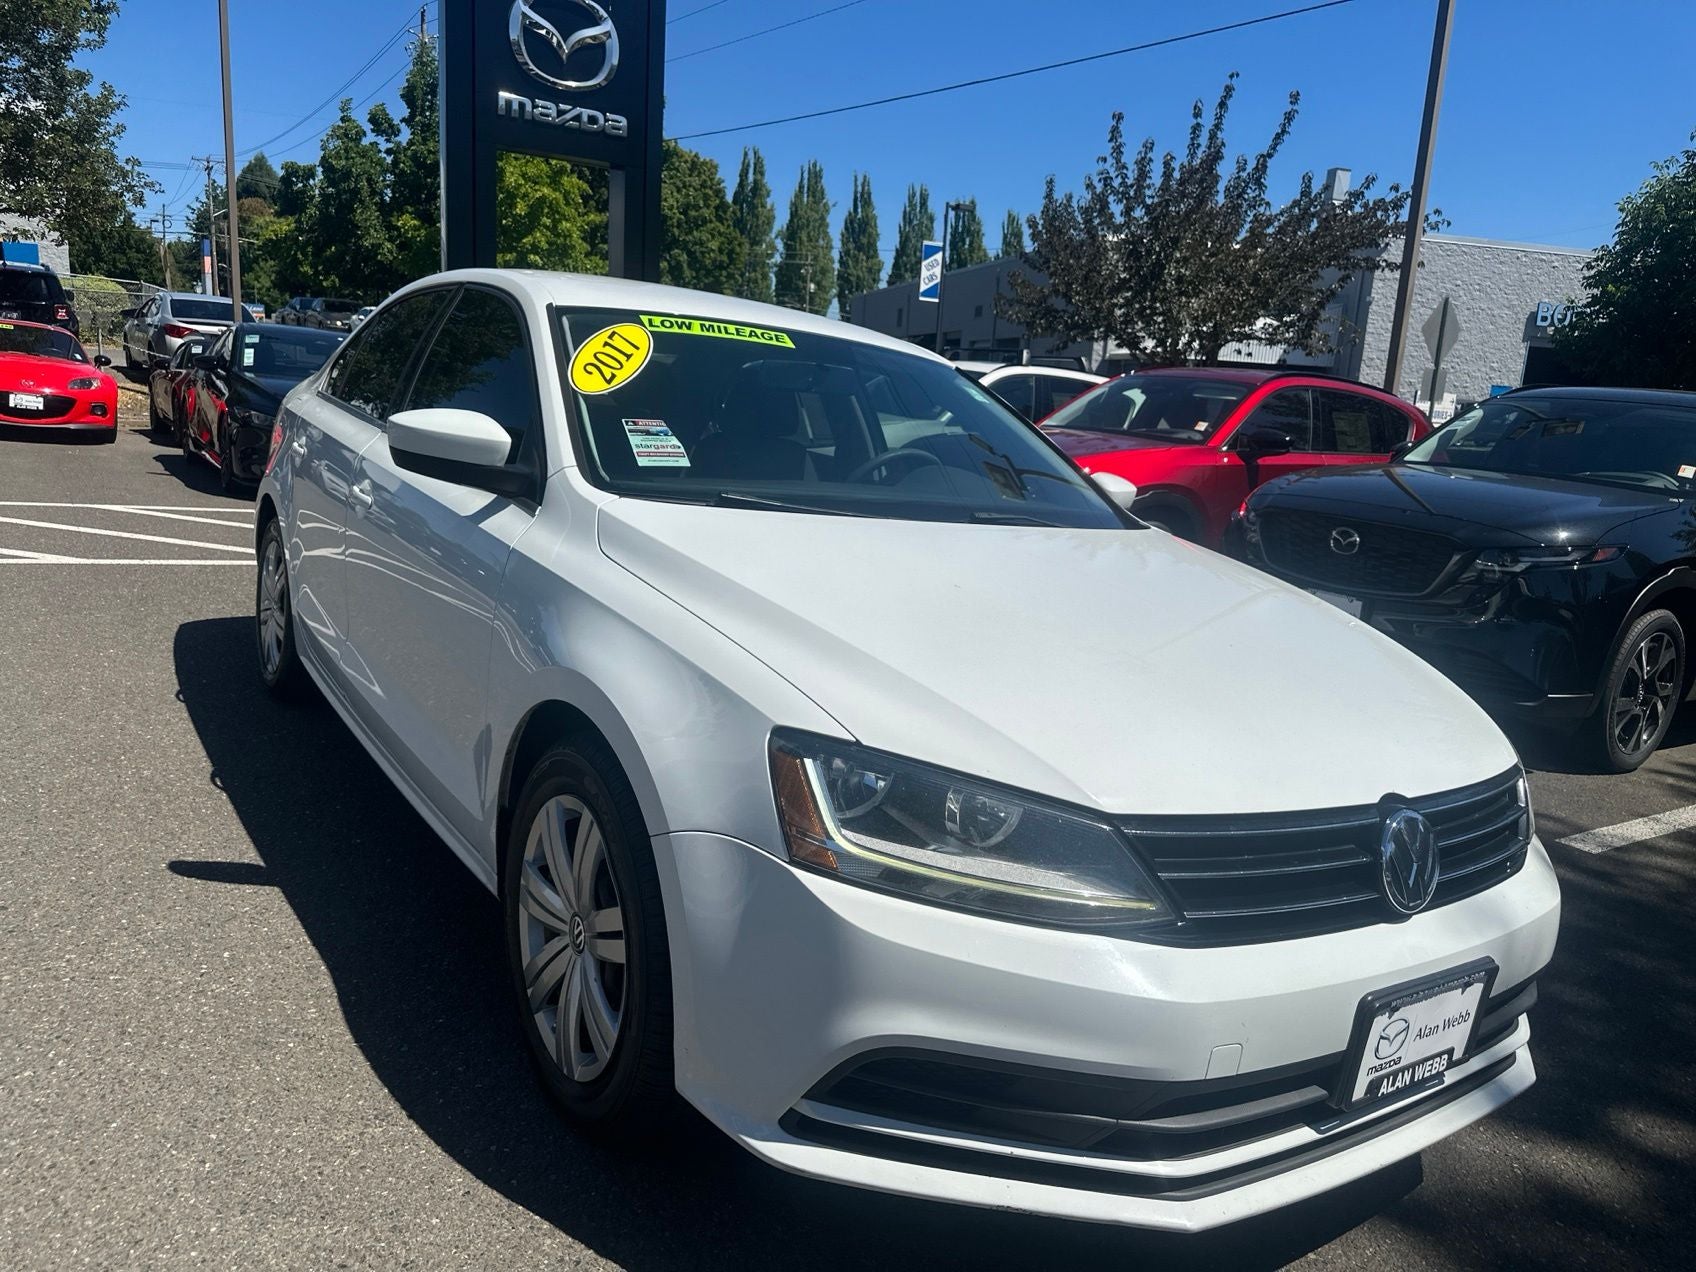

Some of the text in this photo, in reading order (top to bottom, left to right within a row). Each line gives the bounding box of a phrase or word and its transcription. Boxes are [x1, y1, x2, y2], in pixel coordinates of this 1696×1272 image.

[922, 271, 939, 286] CARS
[923, 258, 940, 272] USED
[1536, 301, 1579, 328] BO
[647, 317, 787, 344] LOW MILEAGE
[583, 330, 641, 385] 2017
[1413, 1009, 1471, 1042] Alan Webb
[1366, 1056, 1402, 1076] mazda
[1378, 1054, 1449, 1097] ALAN WEBB
